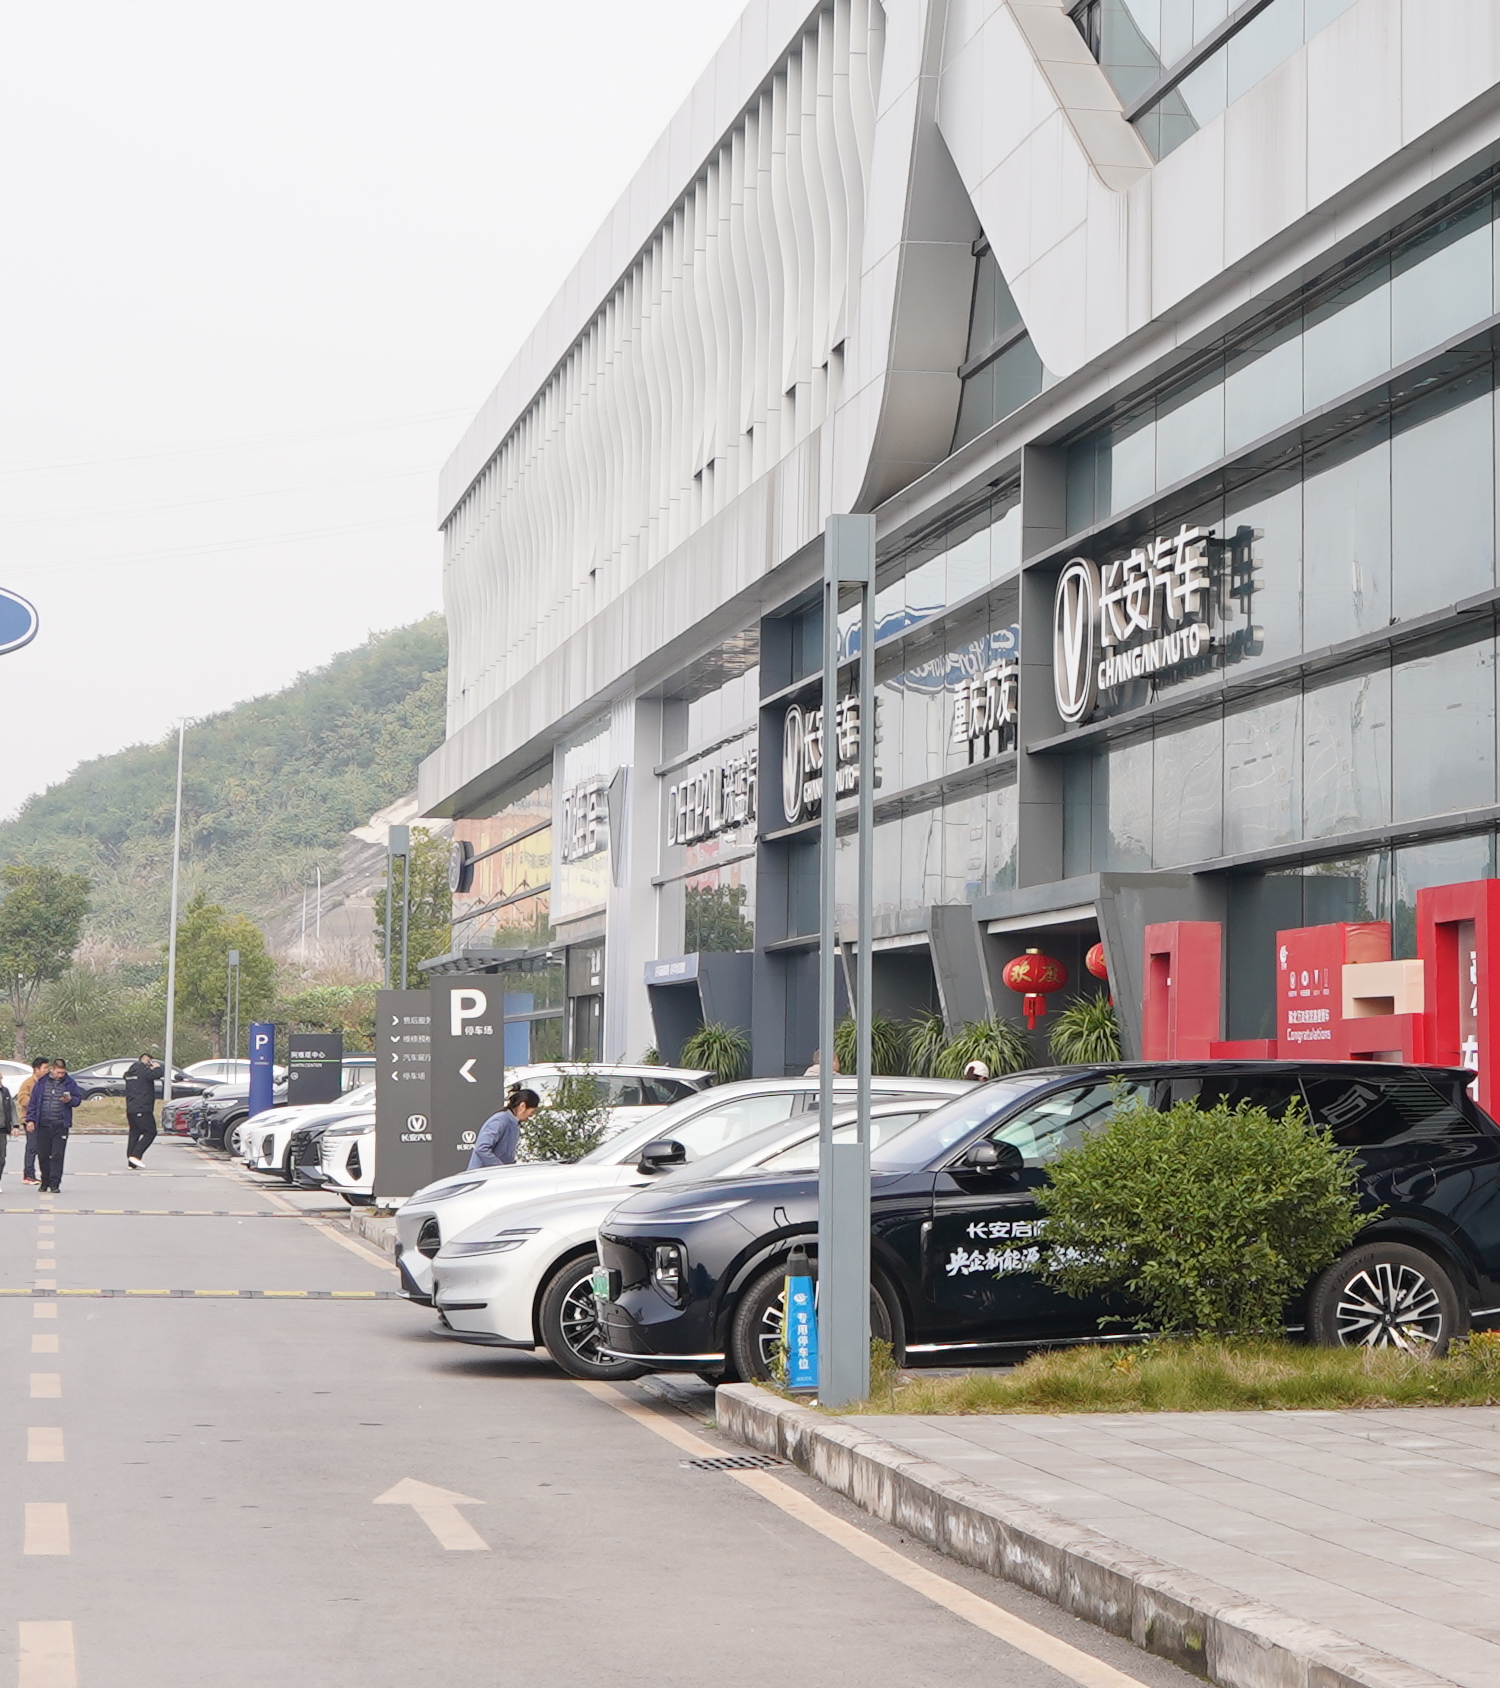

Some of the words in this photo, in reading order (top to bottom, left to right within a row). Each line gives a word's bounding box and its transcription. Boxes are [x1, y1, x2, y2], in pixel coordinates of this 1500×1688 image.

[1098, 524, 1210, 647] 长安汽车
[1098, 639, 1159, 690] CHANGAN
[1162, 623, 1210, 666] AUTO
[953, 659, 1018, 743] 重庆万友
[451, 989, 487, 1036] P
[465, 1025, 493, 1035] 停车场
[255, 1034, 269, 1050] P
